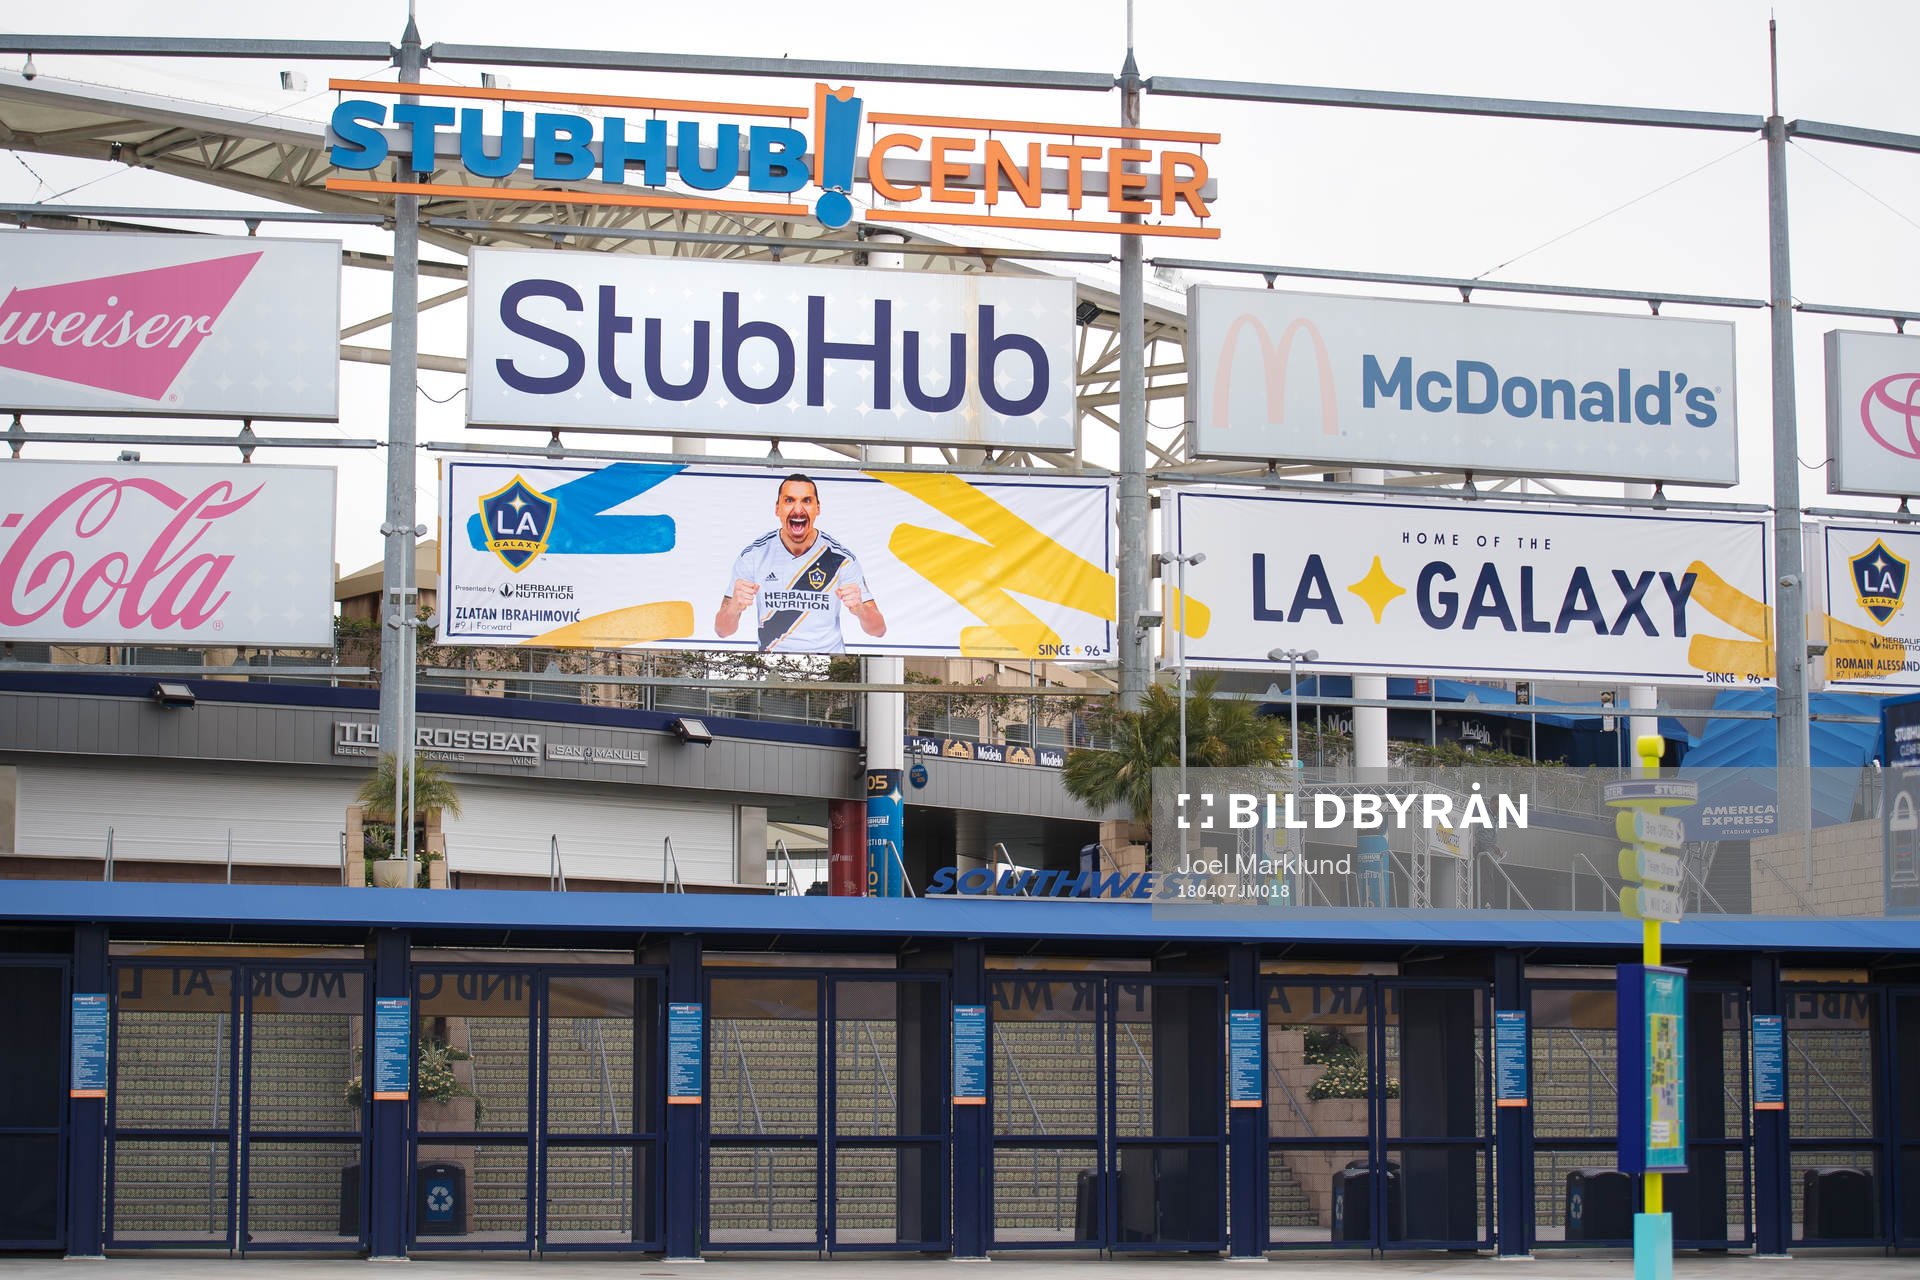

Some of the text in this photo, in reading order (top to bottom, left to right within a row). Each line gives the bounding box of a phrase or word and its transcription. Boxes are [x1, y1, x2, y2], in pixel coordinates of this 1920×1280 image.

[868, 133, 1212, 217] CENTER
[495, 279, 1050, 417] StubHub
[1362, 354, 1718, 428] McDonald's
[497, 510, 539, 535] LA
[493, 541, 541, 549] GALAXY
[1402, 531, 1552, 550] HOME OF THE
[455, 584, 496, 594] Presented by
[516, 583, 574, 593] HERBALIFE
[1864, 570, 1897, 594] LA
[516, 590, 574, 600] NUTRITION
[764, 592, 829, 602] HERBALIFE
[1252, 552, 1699, 638] LA GALAXY
[1862, 597, 1899, 606] GALAXY
[765, 600, 829, 610] NUTRITION
[456, 607, 581, 622] ZLATAN IBRAHIMOVIĆ
[455, 621, 512, 631] #9 Forward
[1834, 637, 1859, 645] Presented
[1038, 643, 1101, 657] SINCE 96
[1836, 657, 1873, 670] ROMAIN
[1706, 671, 1762, 685] SINCE 96
[1836, 671, 1886, 680] #7 Midfielder
[416, 727, 540, 752] ROSSBAR
[337, 746, 367, 756] BEER
[555, 745, 646, 761] SAN MANUEL
[978, 746, 1002, 762] Modelo
[512, 756, 538, 765] WINE
[1040, 752, 1064, 767] Modelo
[1702, 815, 1775, 826] EXPRESS
[926, 866, 1210, 899] SOUTHWEST
